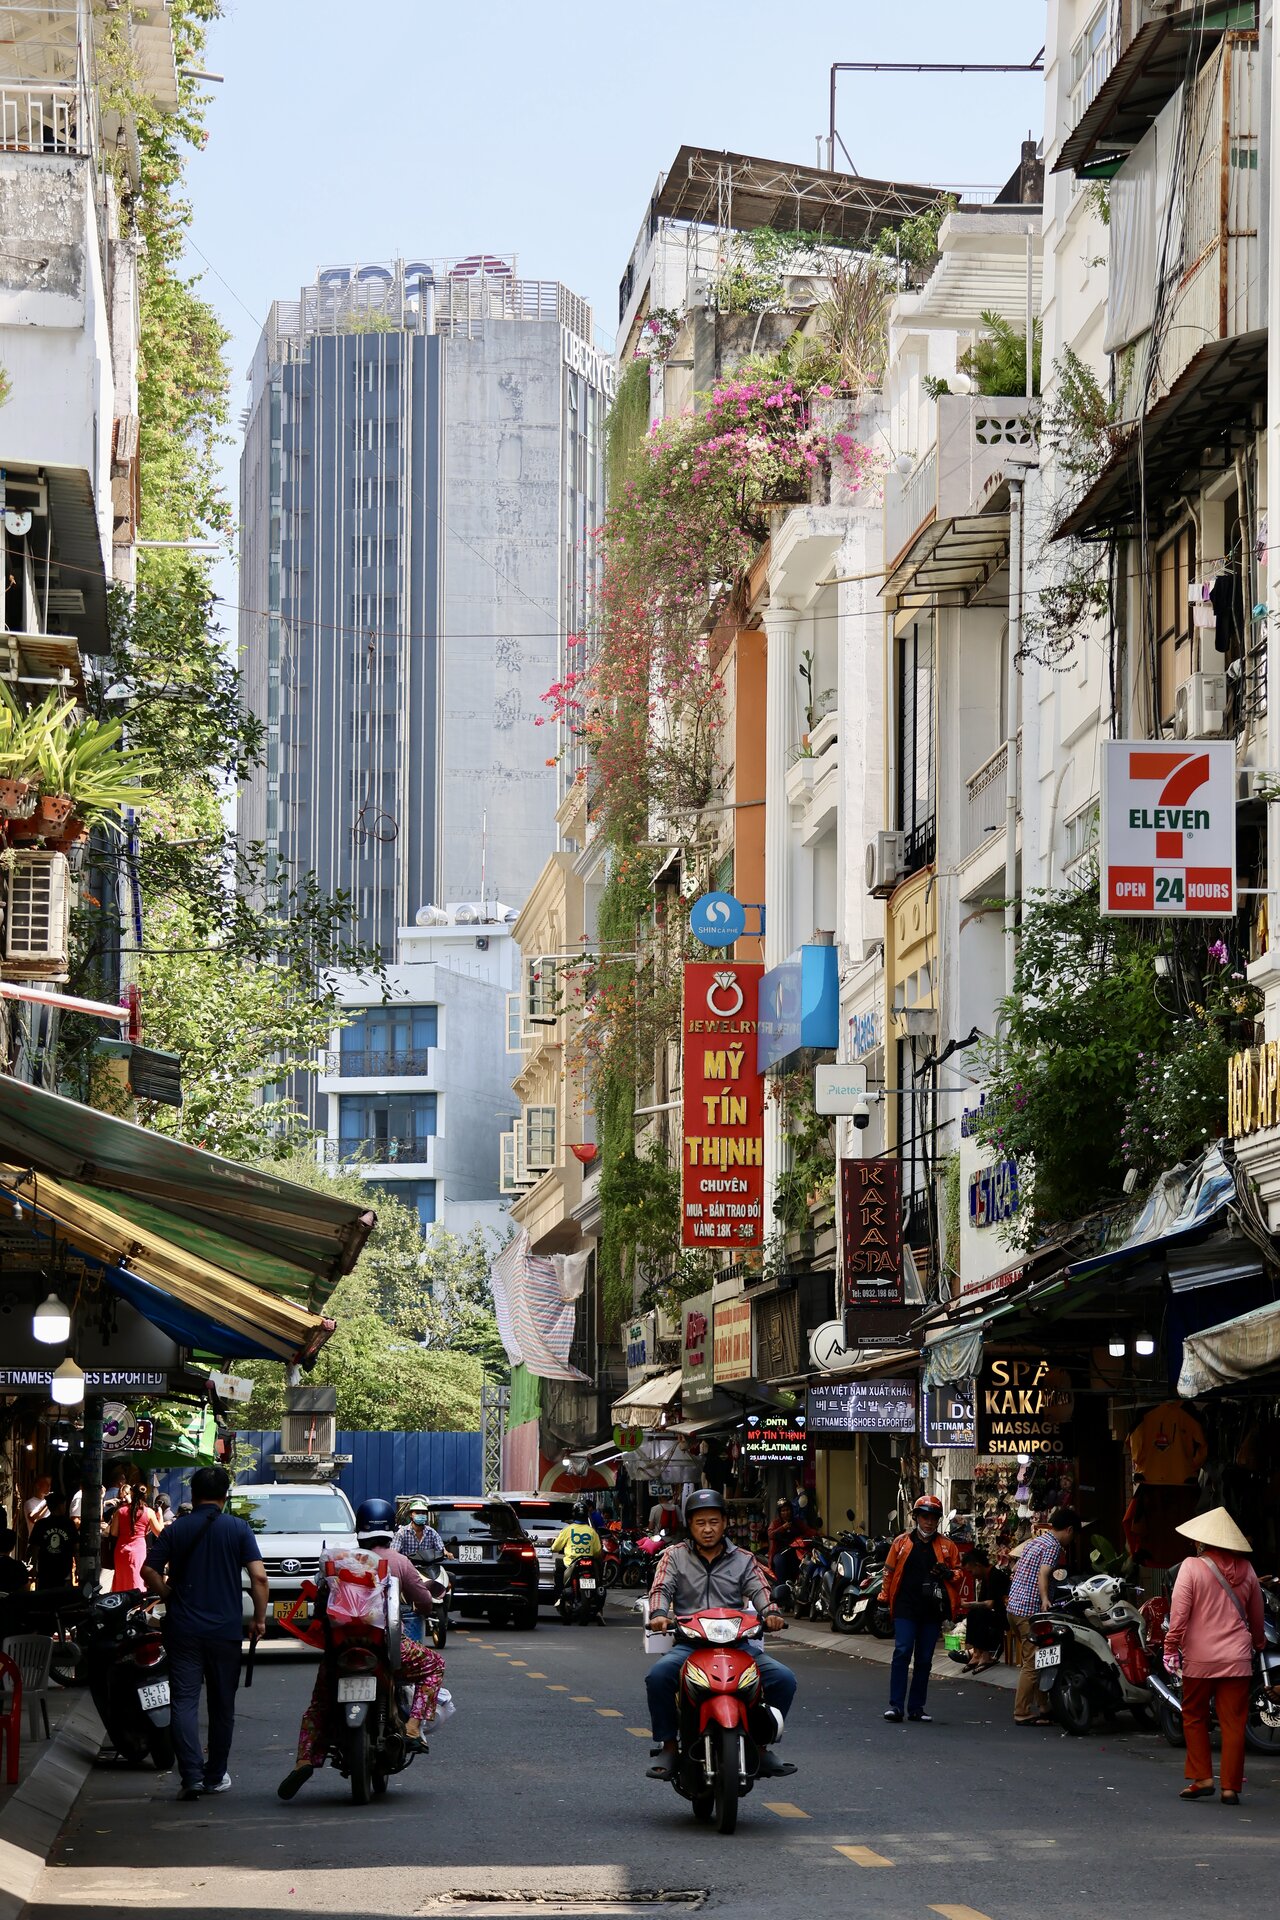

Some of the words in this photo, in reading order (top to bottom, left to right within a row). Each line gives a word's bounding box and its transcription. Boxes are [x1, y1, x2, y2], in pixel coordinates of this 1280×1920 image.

[1115, 882, 1147, 897] OPEN
[1155, 877, 1184, 903] 24
[1188, 883, 1229, 899] HOURS
[698, 926, 717, 934] SHIN
[703, 1041, 745, 1080] MỸ
[702, 1086, 748, 1125] TÍN
[684, 1136, 763, 1173] THỊNH
[699, 1177, 748, 1193] CHUYÊN
[686, 1203, 703, 1218] MUA
[709, 1200, 725, 1218] BÁN
[726, 1203, 747, 1218] TRAO
[747, 1197, 761, 1218] ĐỔI
[693, 1220, 715, 1238] VÀNG
[716, 1223, 732, 1238] 18K
[851, 1250, 898, 1274] SPA
[851, 1289, 862, 1298] Tel:
[103, 1372, 163, 1385] EXPORTED
[991, 1360, 1050, 1387] SPA
[830, 1384, 848, 1398] VIỆT
[849, 1386, 867, 1397] NAM
[868, 1382, 889, 1397] XUẤT
[815, 1400, 850, 1412] 베트남
[856, 1400, 879, 1412] 신발
[766, 1418, 788, 1426] DNTN
[810, 1417, 851, 1428] VIETNAMESE
[852, 1417, 876, 1428] SHOES
[877, 1417, 913, 1428] EXPORTED
[930, 1422, 964, 1430] VIETNAM
[991, 1421, 1060, 1435] MASSAGE
[747, 1430, 761, 1440] MỸ
[762, 1430, 777, 1440] TÍN
[988, 1440, 1064, 1453] SHAMPOO
[571, 1528, 592, 1545] be
